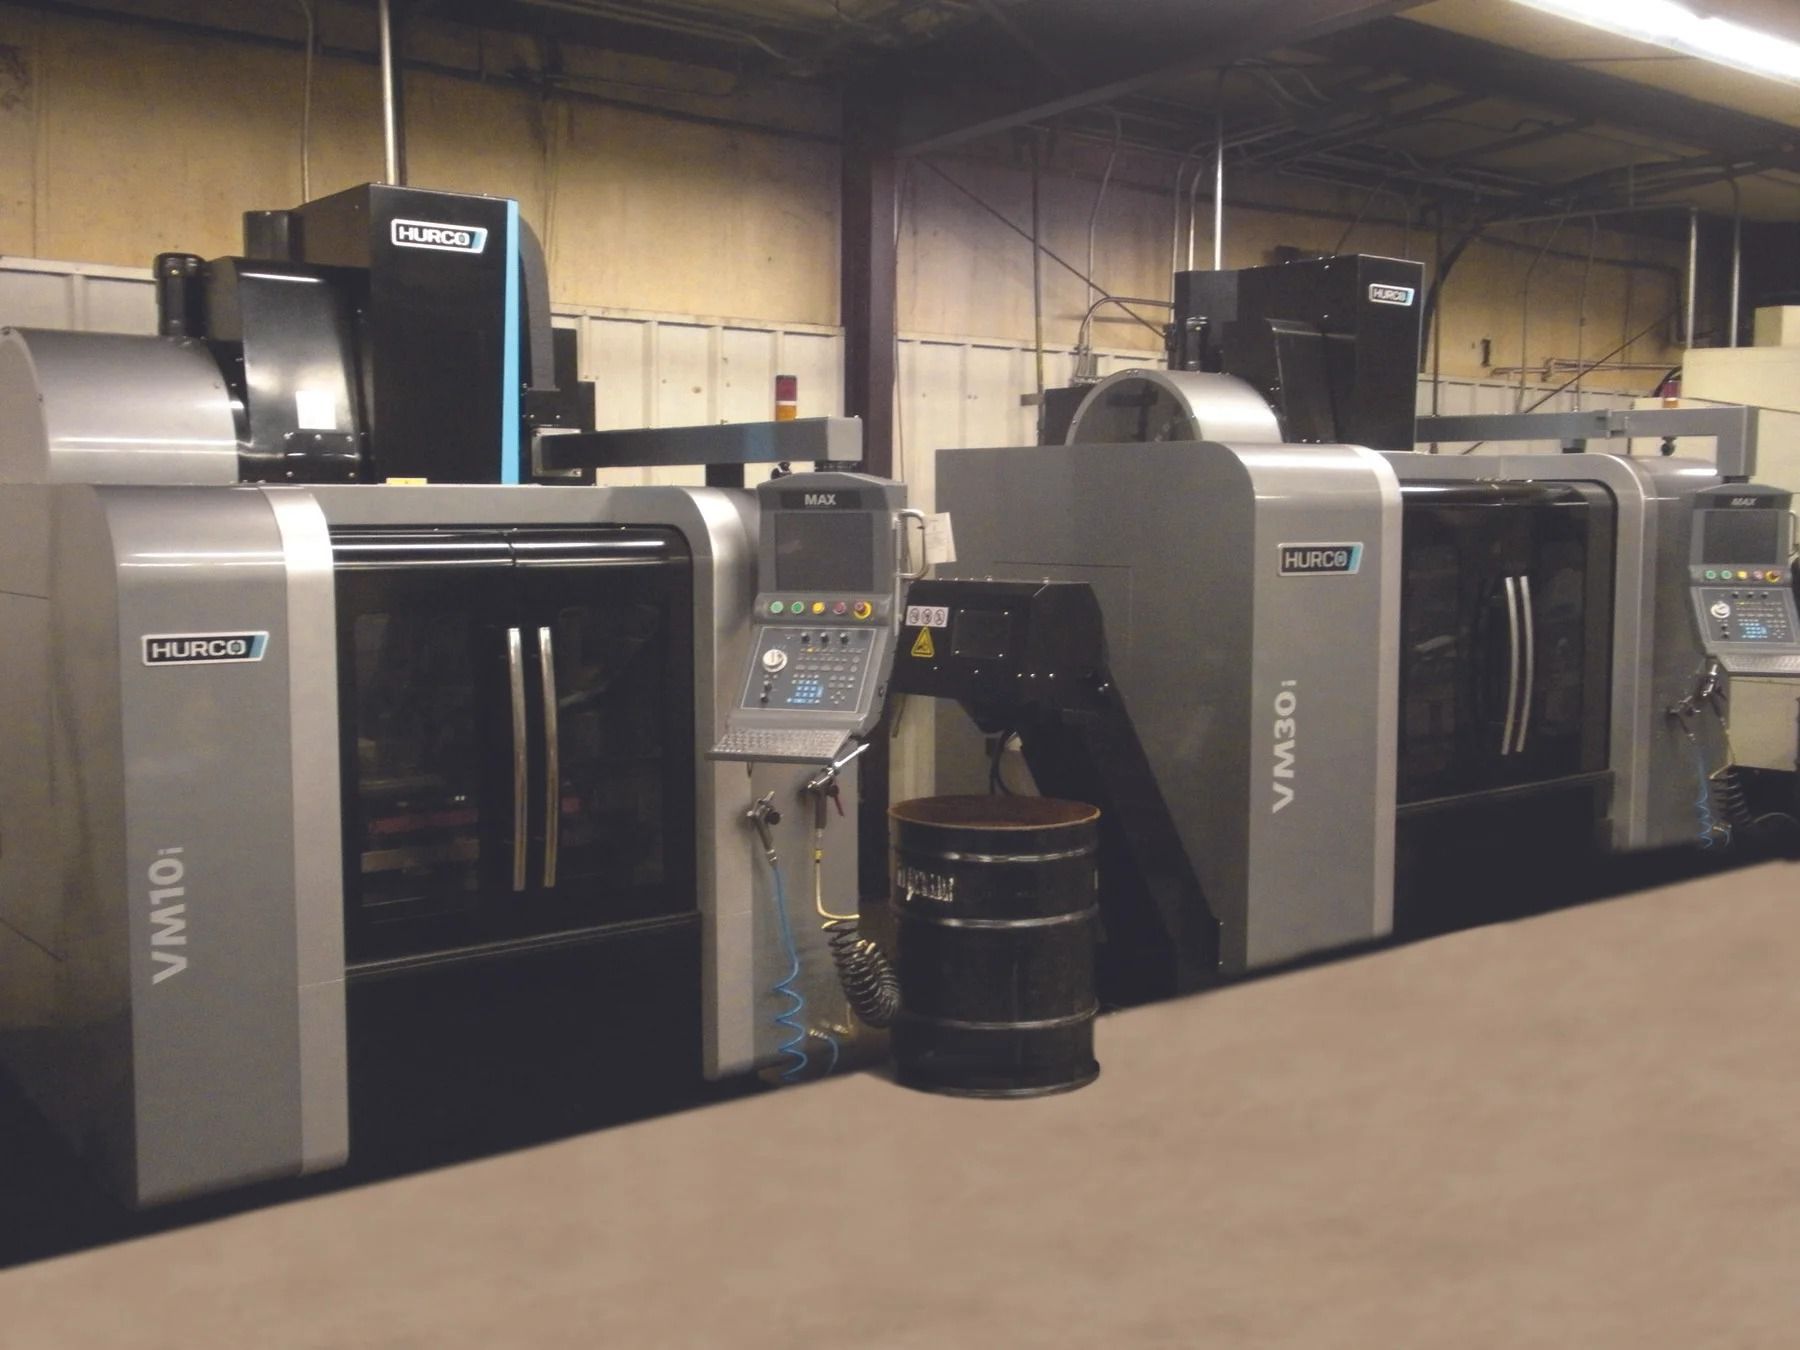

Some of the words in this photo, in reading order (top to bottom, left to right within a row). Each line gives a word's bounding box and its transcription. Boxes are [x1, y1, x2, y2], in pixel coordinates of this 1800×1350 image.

[399, 226, 470, 246] HURCO
[1373, 288, 1406, 302] HURCO
[804, 494, 837, 505] MAX
[1731, 497, 1758, 506] MAX
[1285, 551, 1347, 568] HURCO
[152, 639, 247, 658] HURCO
[1272, 680, 1297, 814] VM30i
[148, 846, 188, 985] VM10i
